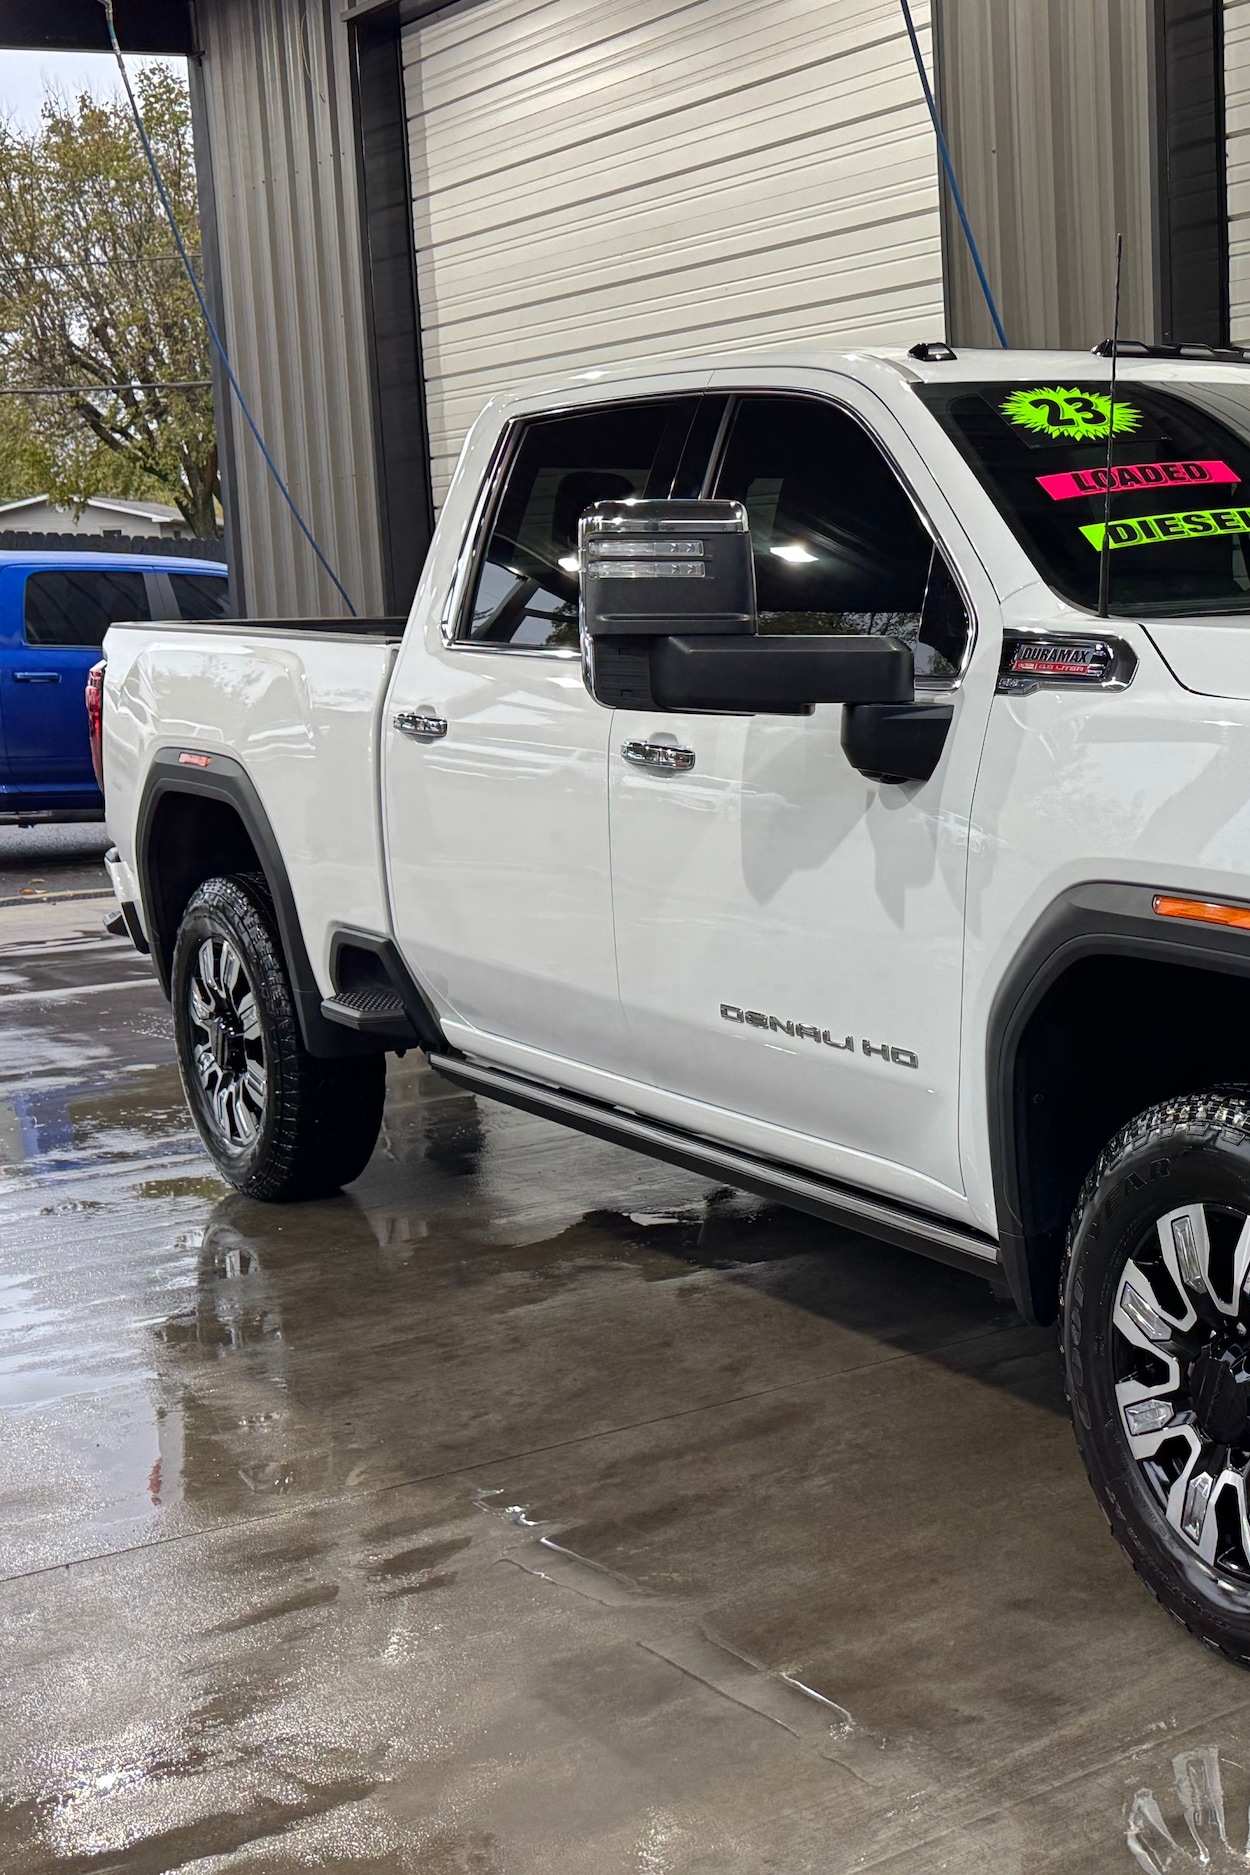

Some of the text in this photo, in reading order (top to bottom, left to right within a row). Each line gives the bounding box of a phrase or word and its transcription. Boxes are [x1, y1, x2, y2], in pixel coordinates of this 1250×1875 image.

[1028, 396, 1109, 428] 23
[1070, 463, 1210, 493] LOADED
[1021, 646, 1090, 663] DURAMAX
[719, 1003, 919, 1069] DENALI HD
